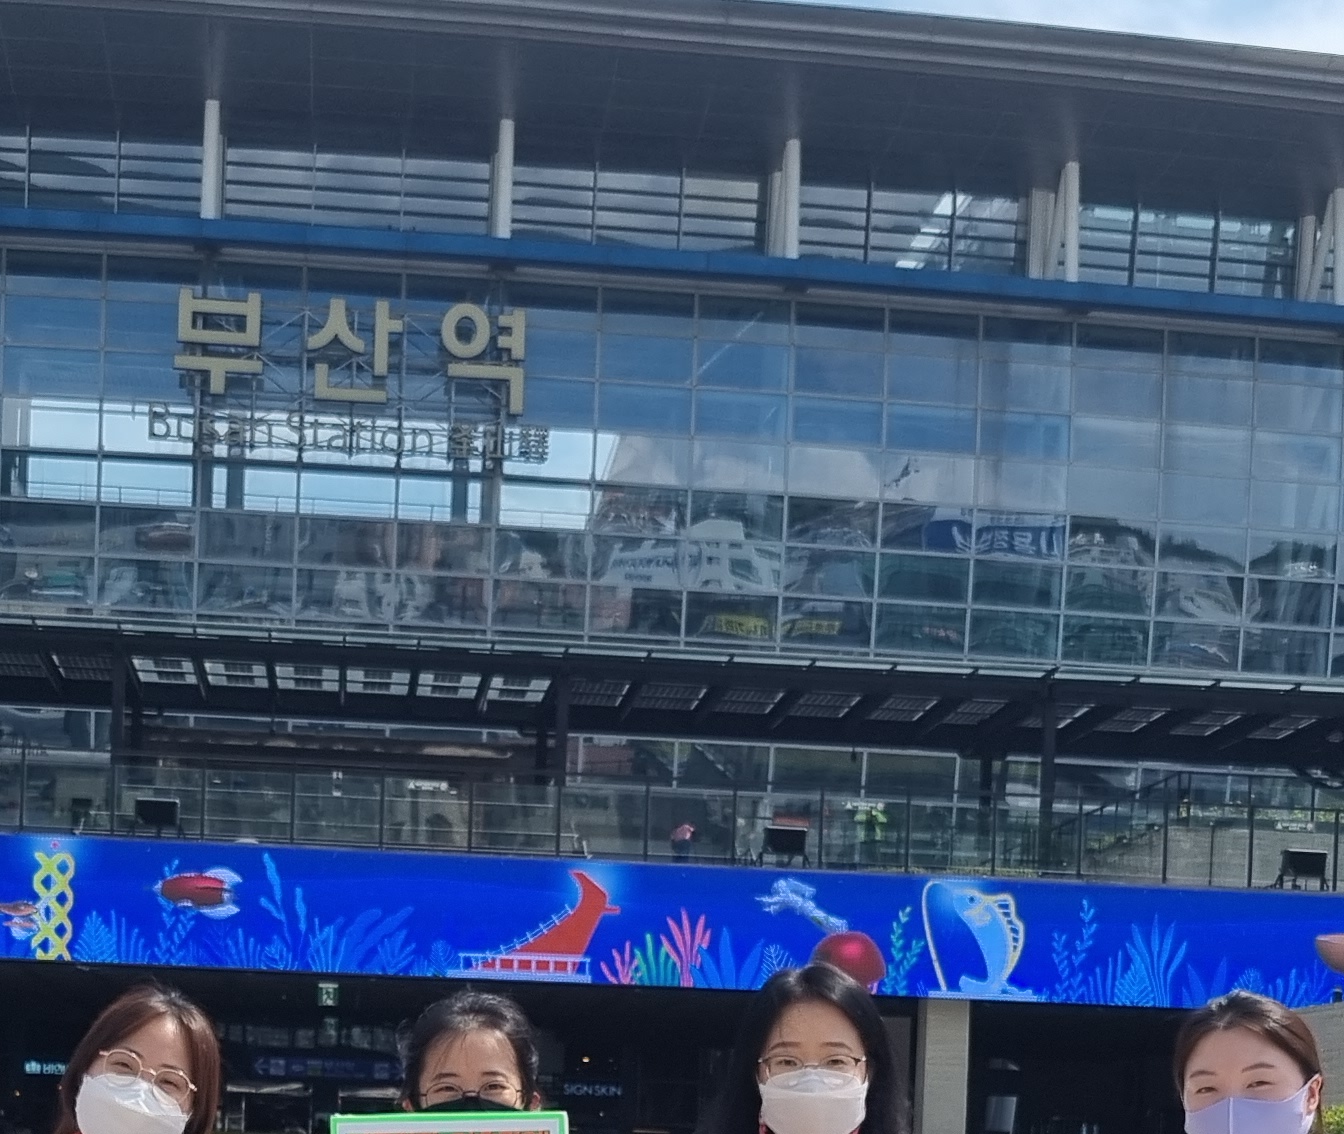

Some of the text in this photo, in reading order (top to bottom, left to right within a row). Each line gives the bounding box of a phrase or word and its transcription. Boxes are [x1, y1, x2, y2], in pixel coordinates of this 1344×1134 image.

[173, 286, 525, 416] 부산역
[147, 402, 435, 456] Busan Station
